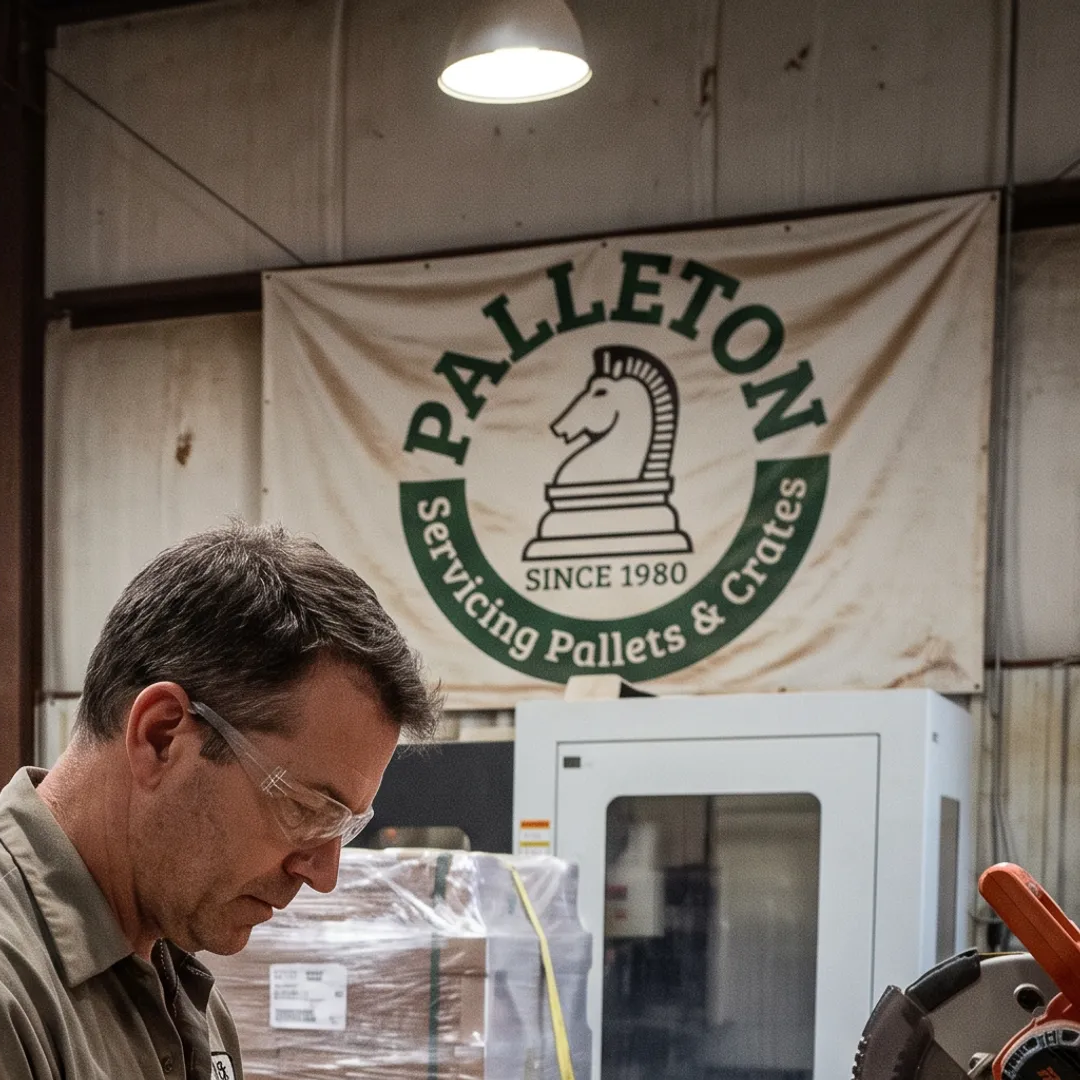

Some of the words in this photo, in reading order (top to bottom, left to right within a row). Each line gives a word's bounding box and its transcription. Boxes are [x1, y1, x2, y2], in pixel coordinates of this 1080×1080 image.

[403, 251, 827, 466] PALLETON
[417, 496, 540, 661] Servicing
[544, 624, 686, 668] Pallets
[691, 600, 725, 635] &
[721, 477, 807, 605] Crates
[525, 565, 612, 591] SINCE
[621, 561, 687, 587] 1980
